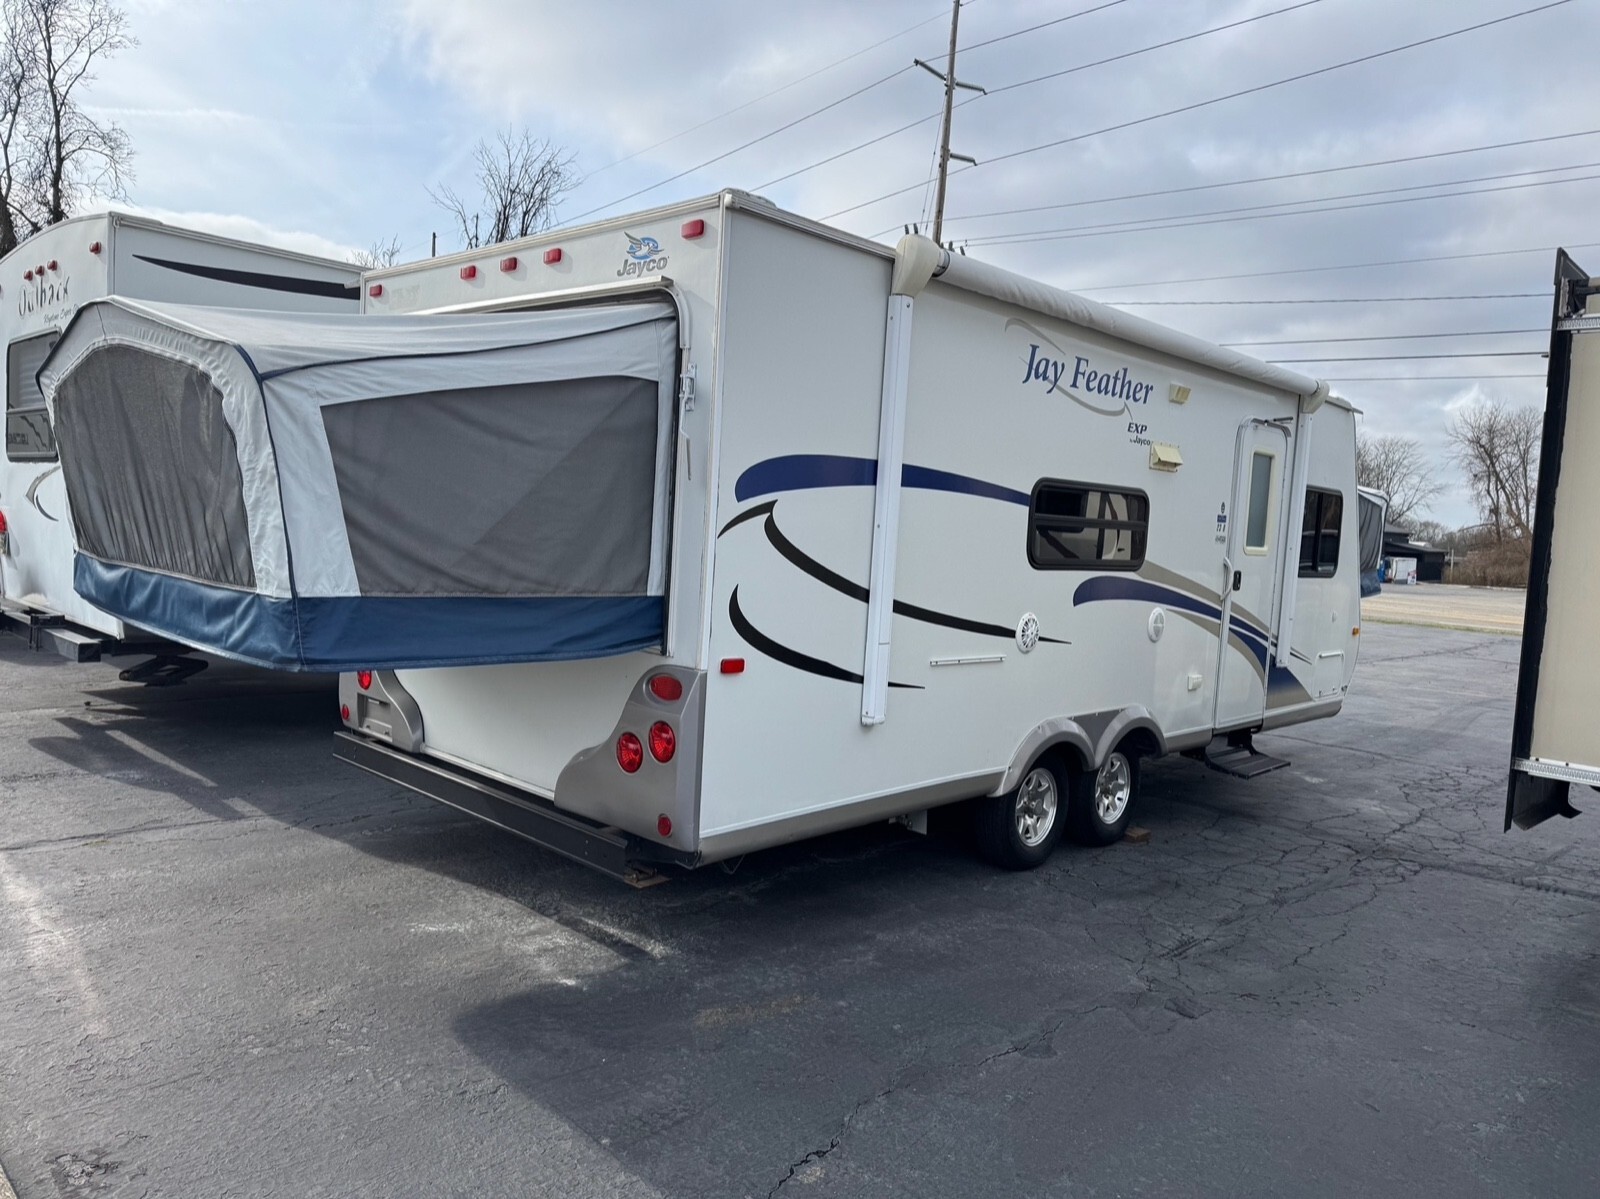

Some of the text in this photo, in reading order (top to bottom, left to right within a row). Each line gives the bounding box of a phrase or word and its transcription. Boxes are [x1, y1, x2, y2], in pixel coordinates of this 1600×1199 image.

[616, 257, 668, 278] Jayco
[1022, 344, 1154, 405] Jay Feather
[1127, 422, 1148, 434] EXP
